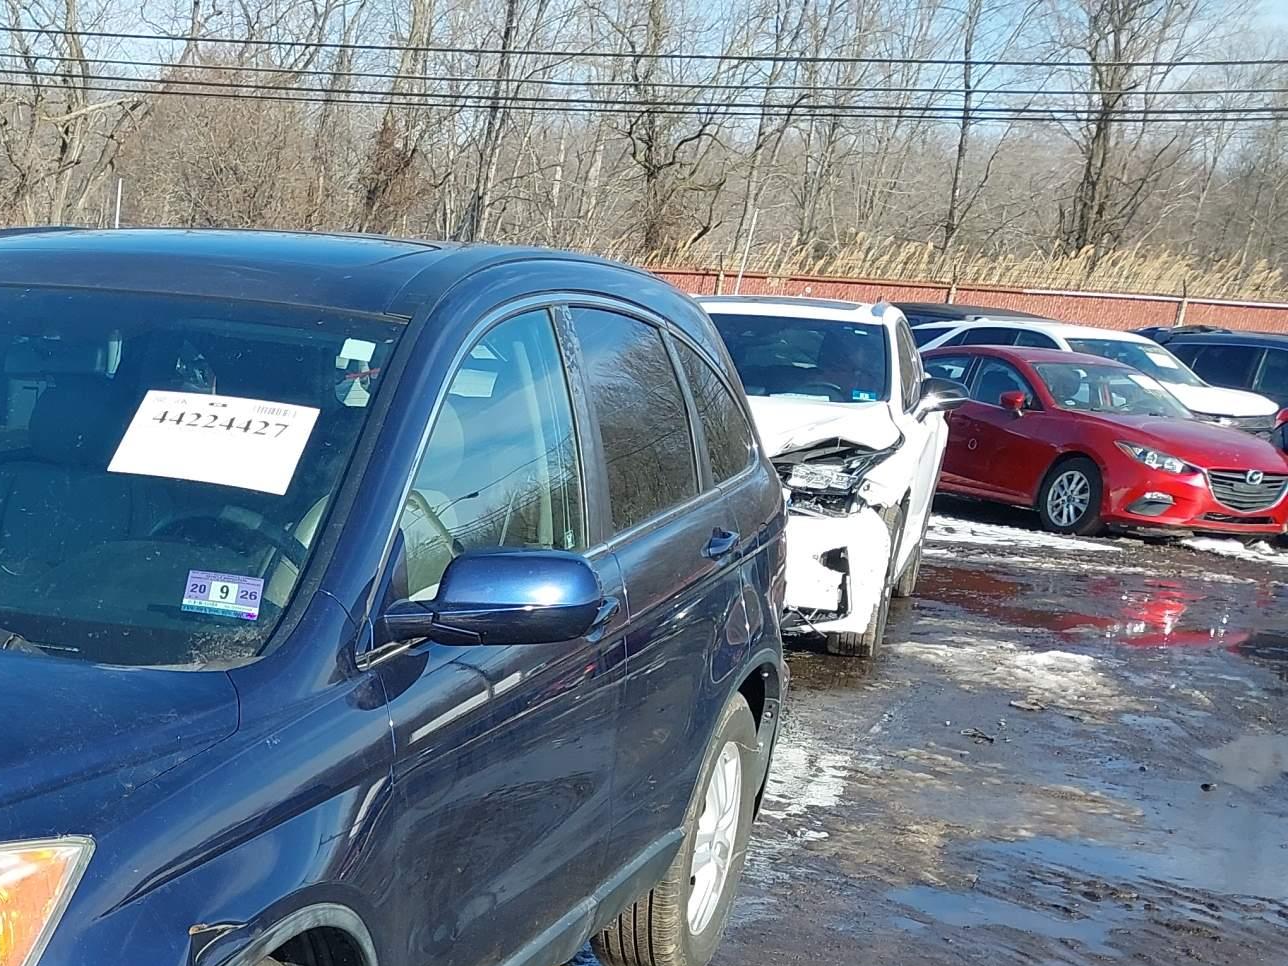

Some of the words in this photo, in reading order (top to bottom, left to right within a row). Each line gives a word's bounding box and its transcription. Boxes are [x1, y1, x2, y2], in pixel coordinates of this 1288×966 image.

[152, 410, 289, 438] 44224427
[190, 583, 207, 594] 20
[219, 585, 230, 600] 9
[240, 590, 258, 601] 26
